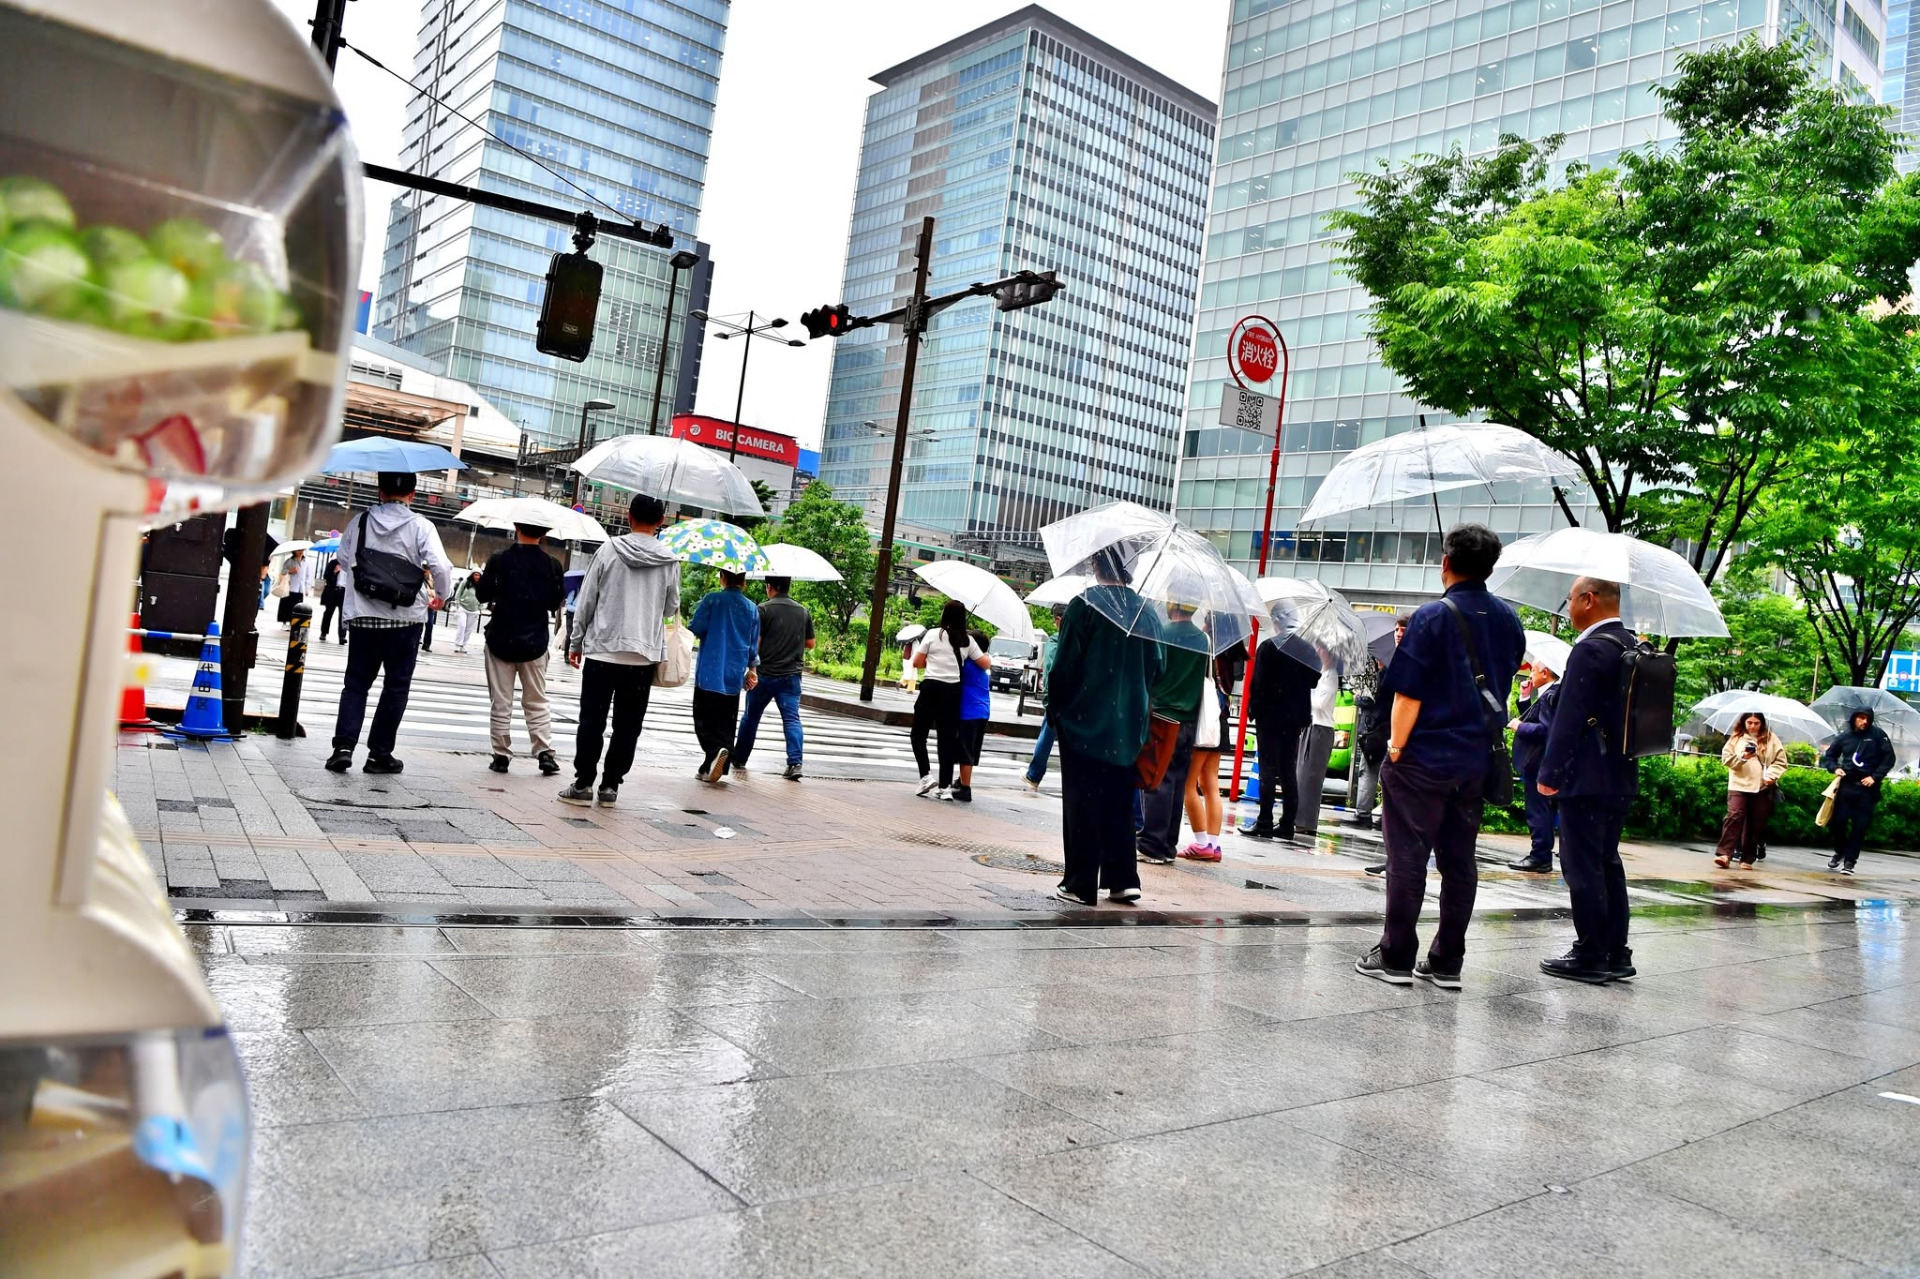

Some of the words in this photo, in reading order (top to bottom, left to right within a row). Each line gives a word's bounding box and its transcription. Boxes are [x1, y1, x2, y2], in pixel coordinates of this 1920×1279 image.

[1241, 340, 1275, 369] 消火栓
[737, 434, 785, 454] CAMERA
